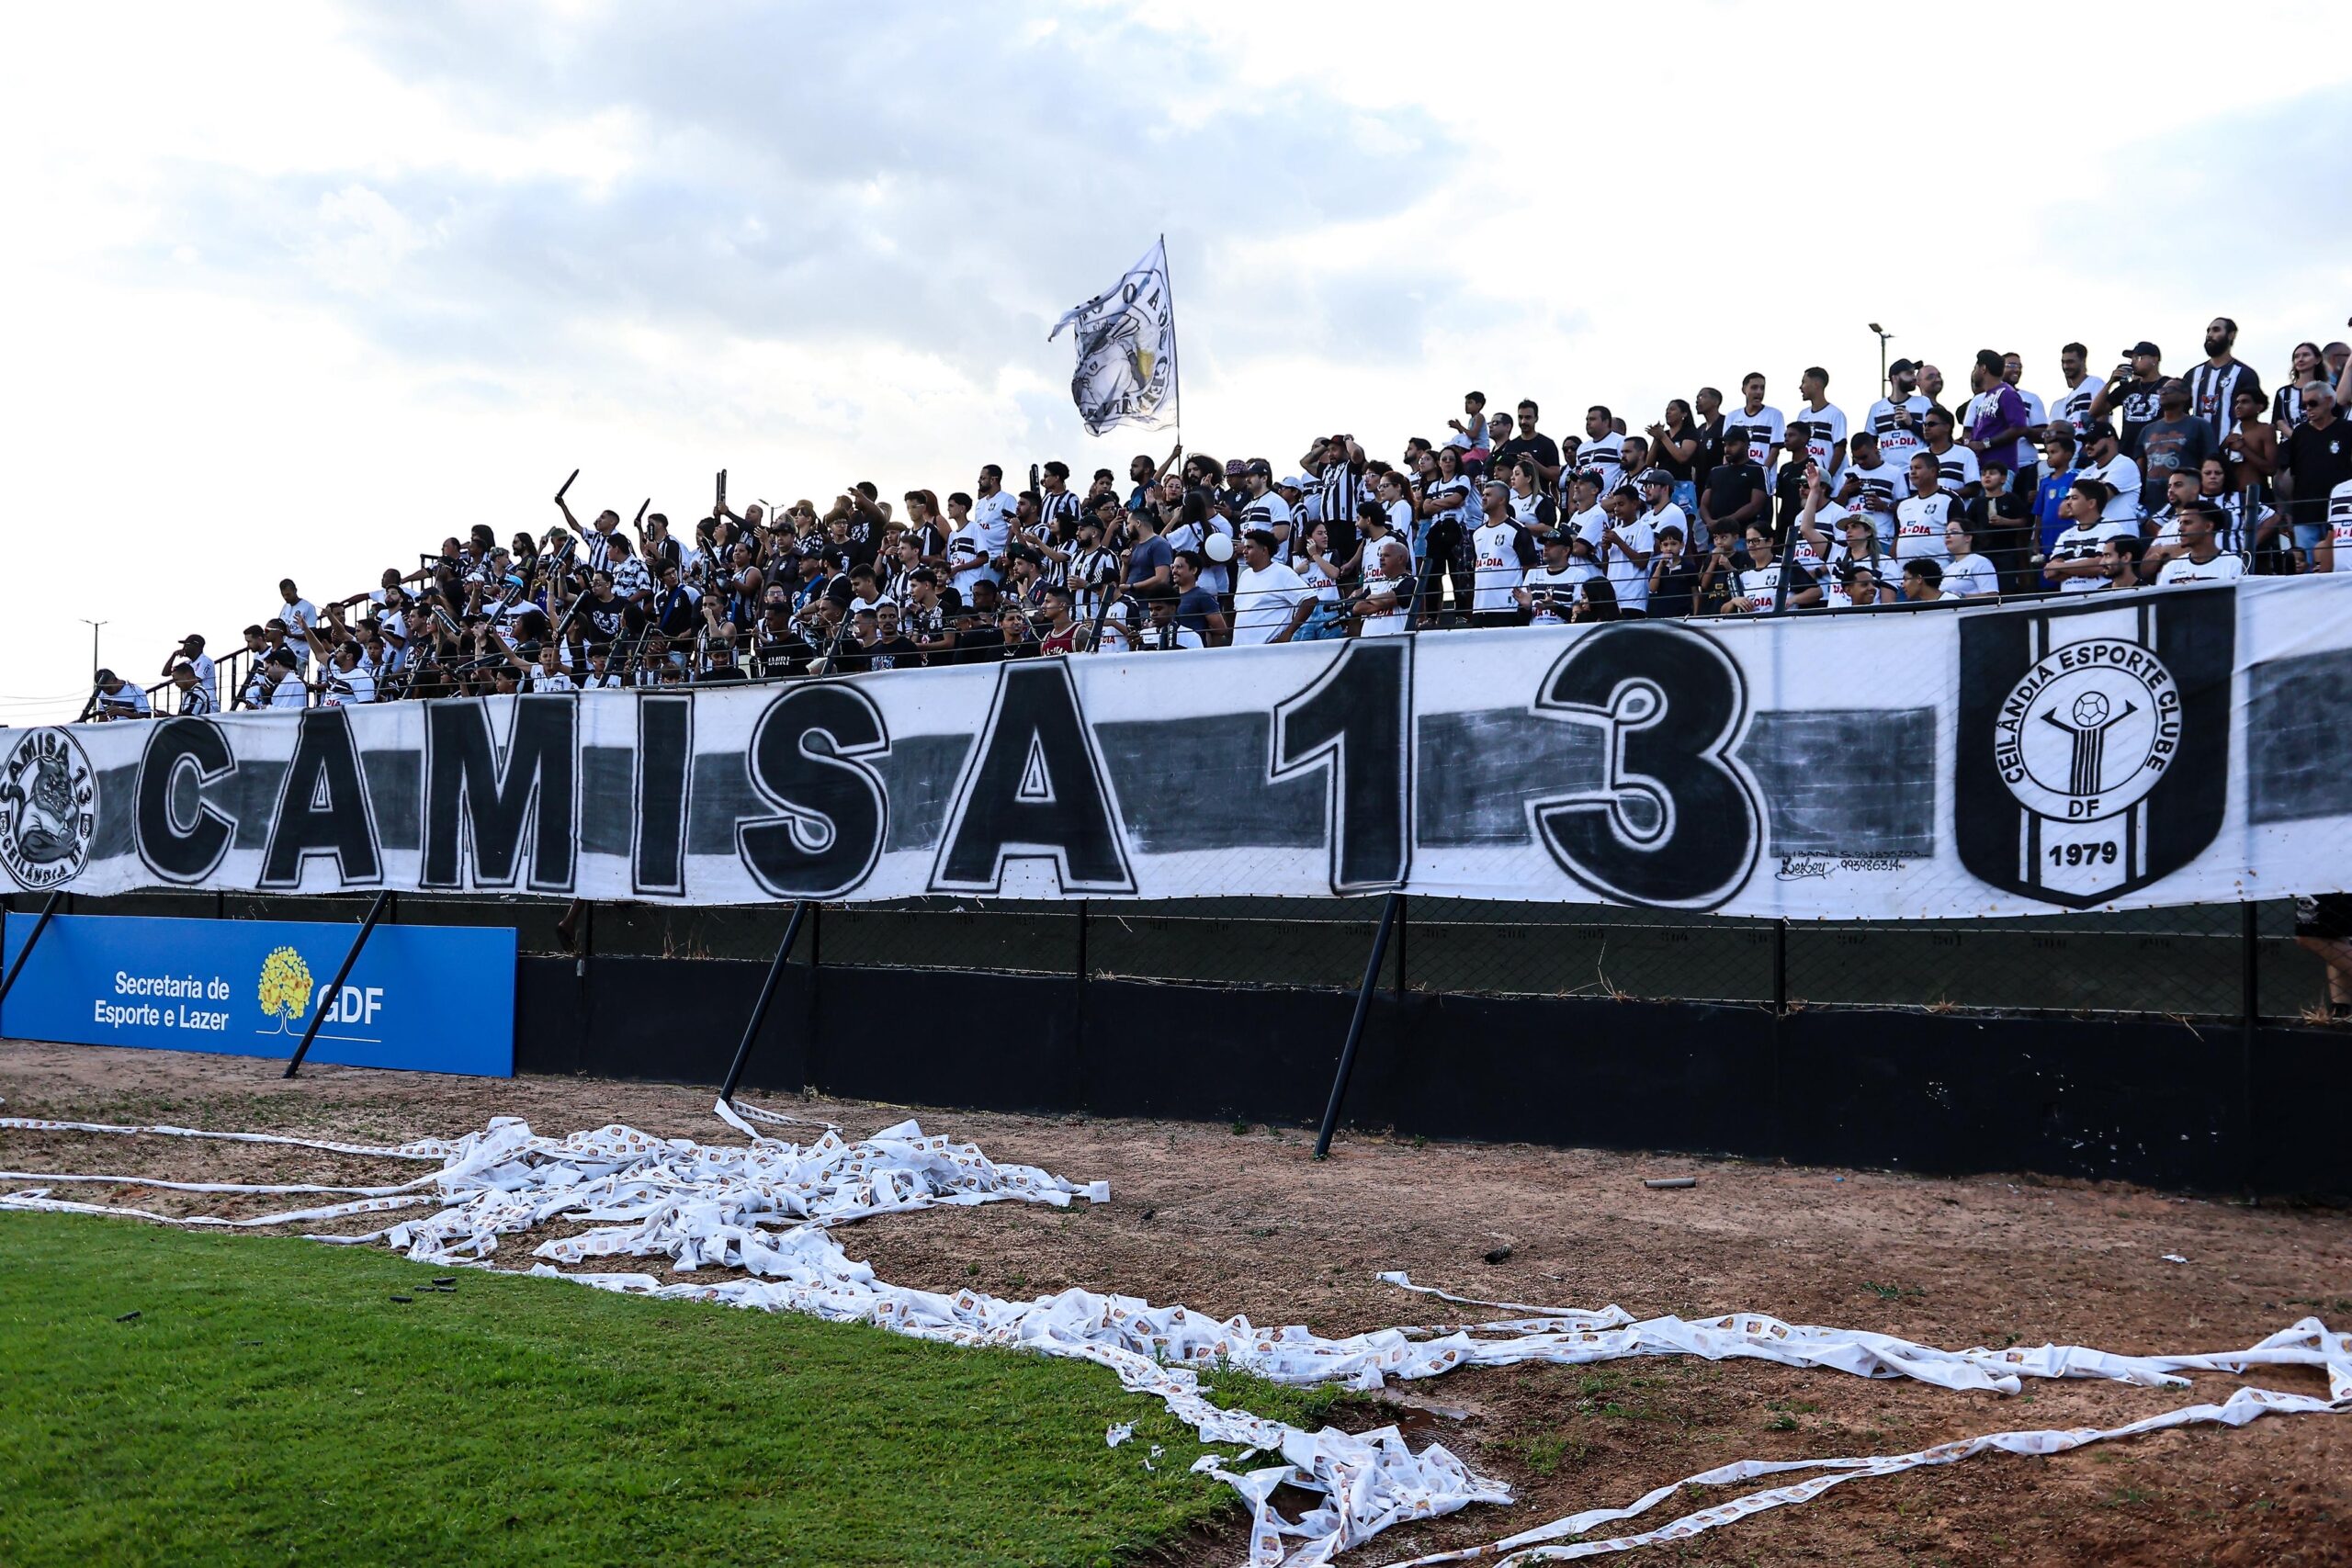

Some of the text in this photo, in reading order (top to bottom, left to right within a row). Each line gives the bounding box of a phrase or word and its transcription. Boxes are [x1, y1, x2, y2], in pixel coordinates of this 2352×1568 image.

[1749, 449, 1764, 458] DIA
[1882, 440, 1894, 449] DIA
[1900, 437, 1917, 446] DIA
[1912, 525, 1931, 535] DIA
[1487, 558, 1503, 567] DIA
[1996, 645, 2177, 784] CEILÂNDIA ESPORTE CLUBE
[132, 619, 1765, 913] CAMISA 13
[2068, 799, 2100, 818] DF
[2048, 840, 2118, 866] 1979
[115, 970, 230, 1000] Secretaria de
[95, 999, 230, 1031] Esporte e Lazer
[317, 984, 384, 1024] GDF
